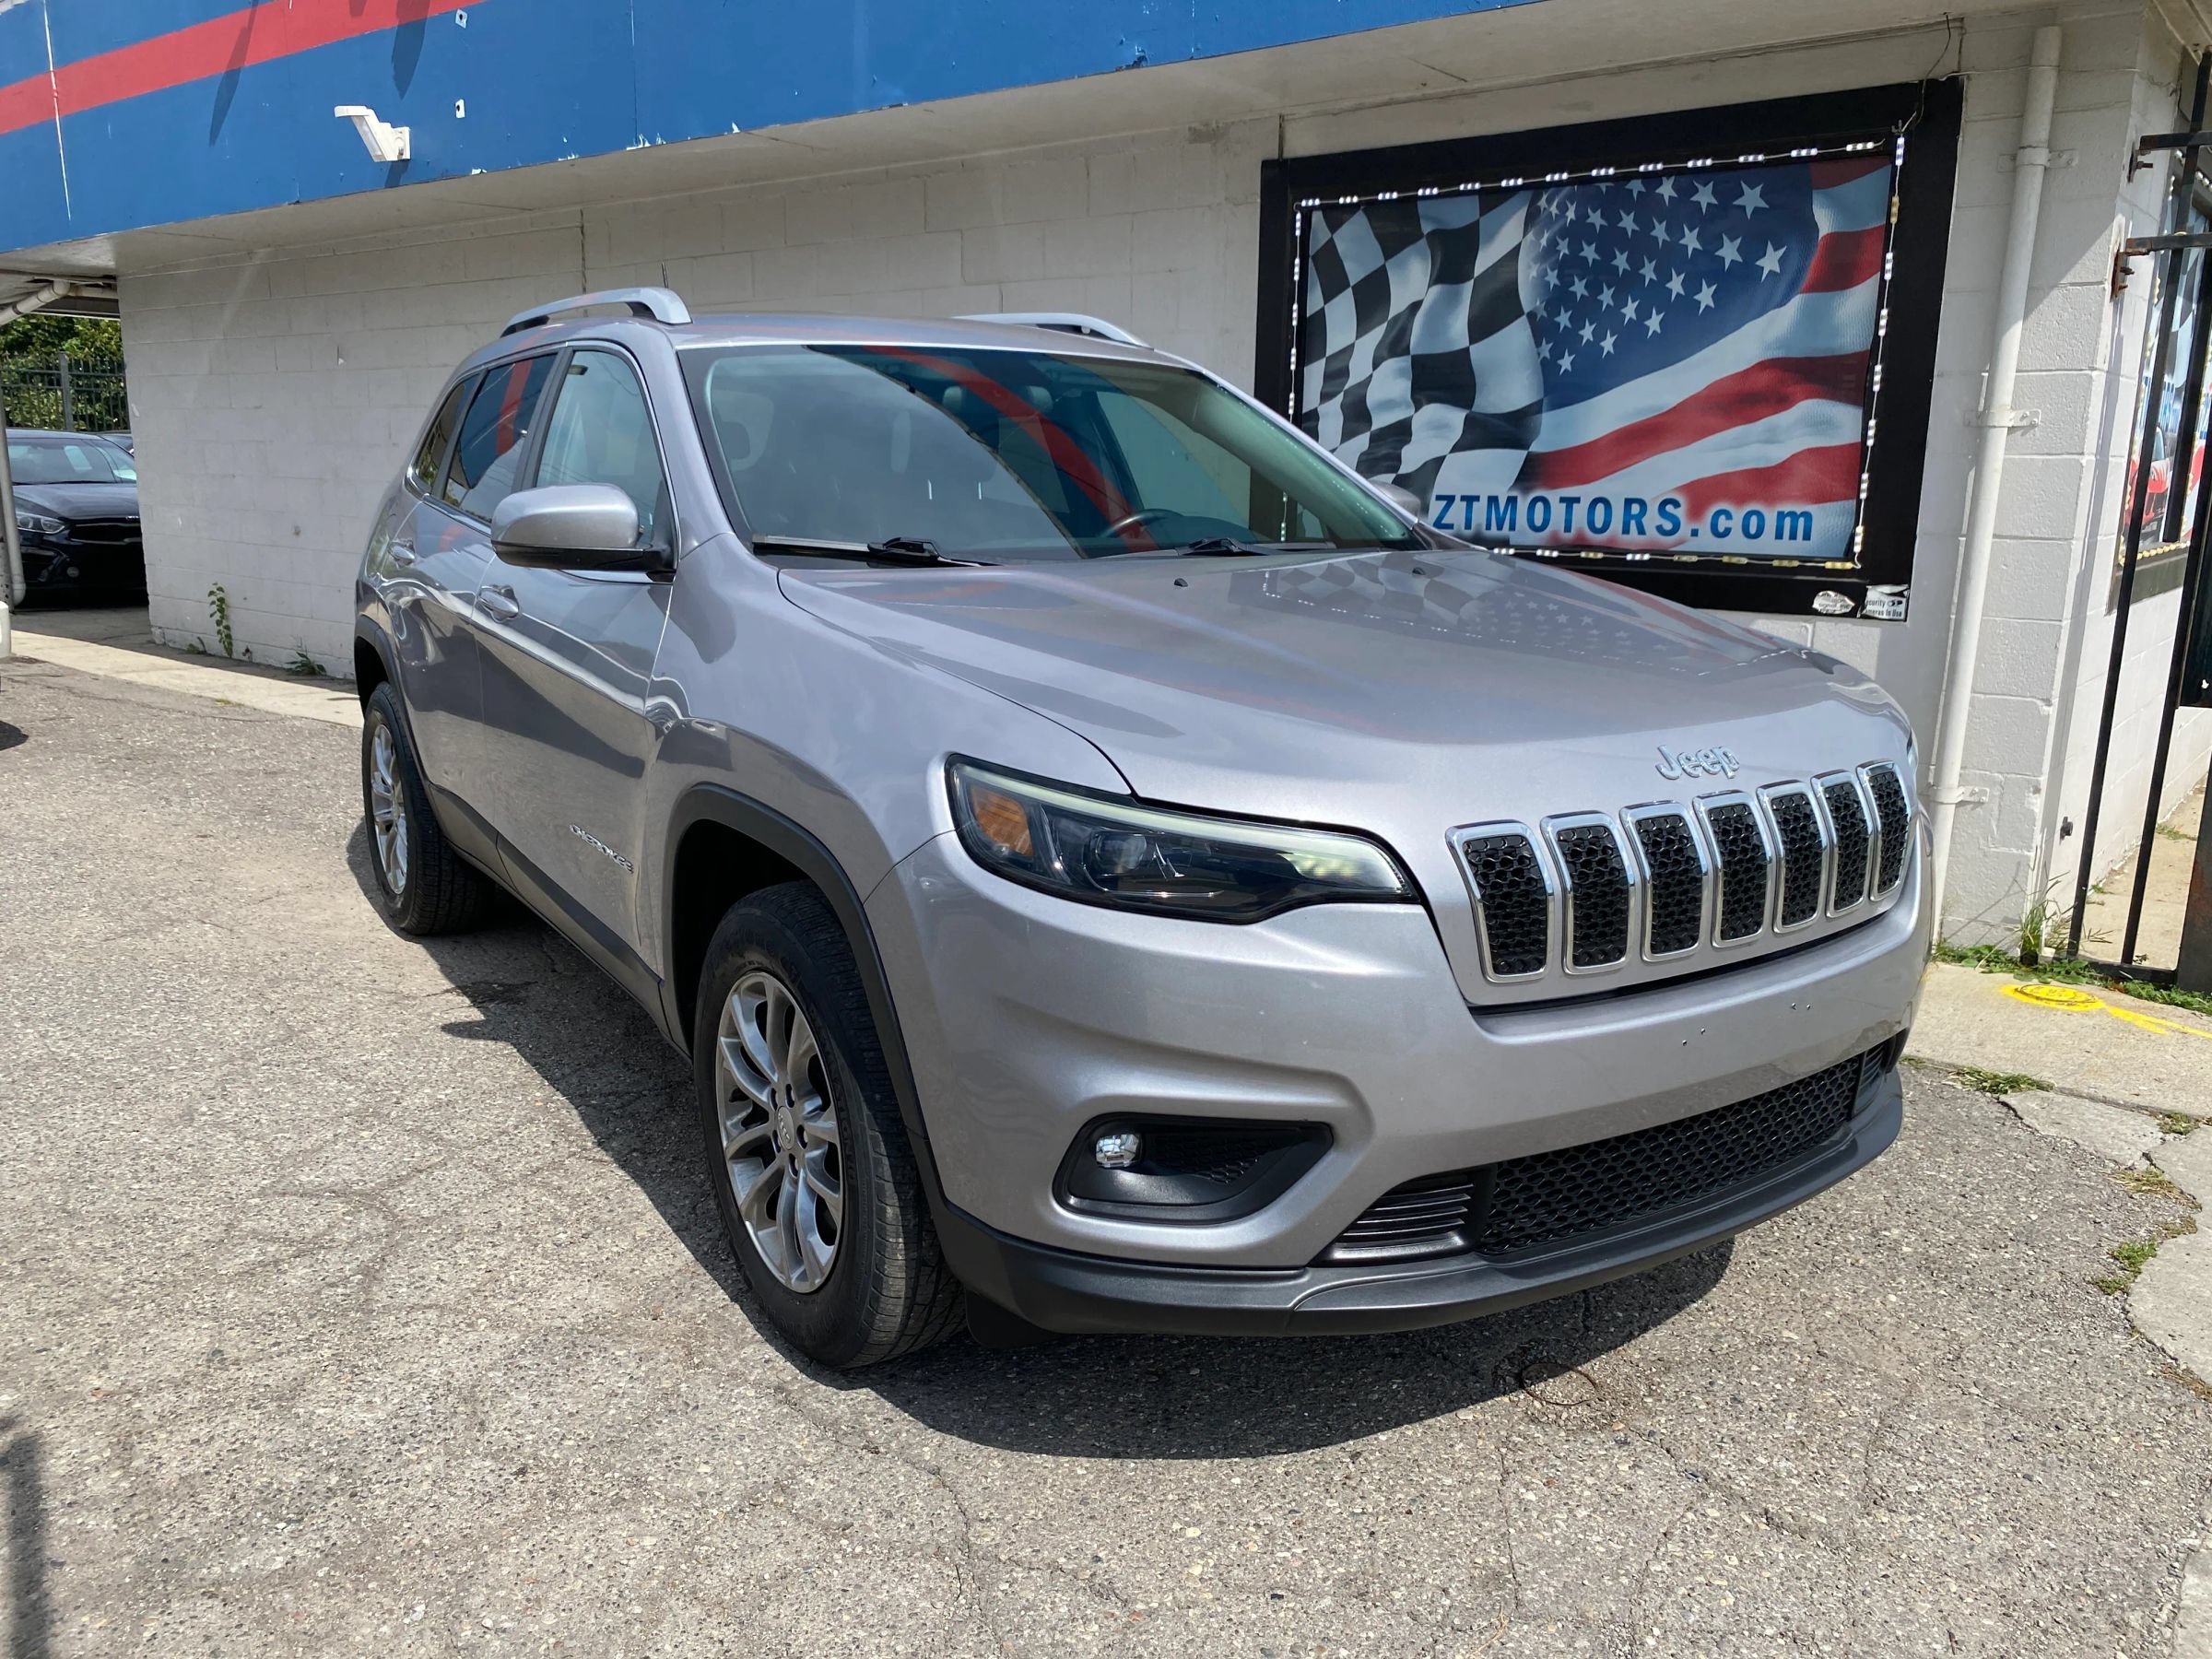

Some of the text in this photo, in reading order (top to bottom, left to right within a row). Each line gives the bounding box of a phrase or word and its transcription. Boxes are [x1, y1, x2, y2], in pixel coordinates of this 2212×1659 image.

[1432, 494, 1814, 542] ZTMOTORS.com
[1865, 599, 1886, 608] ecurity
[1655, 745, 1740, 781] Jeep
